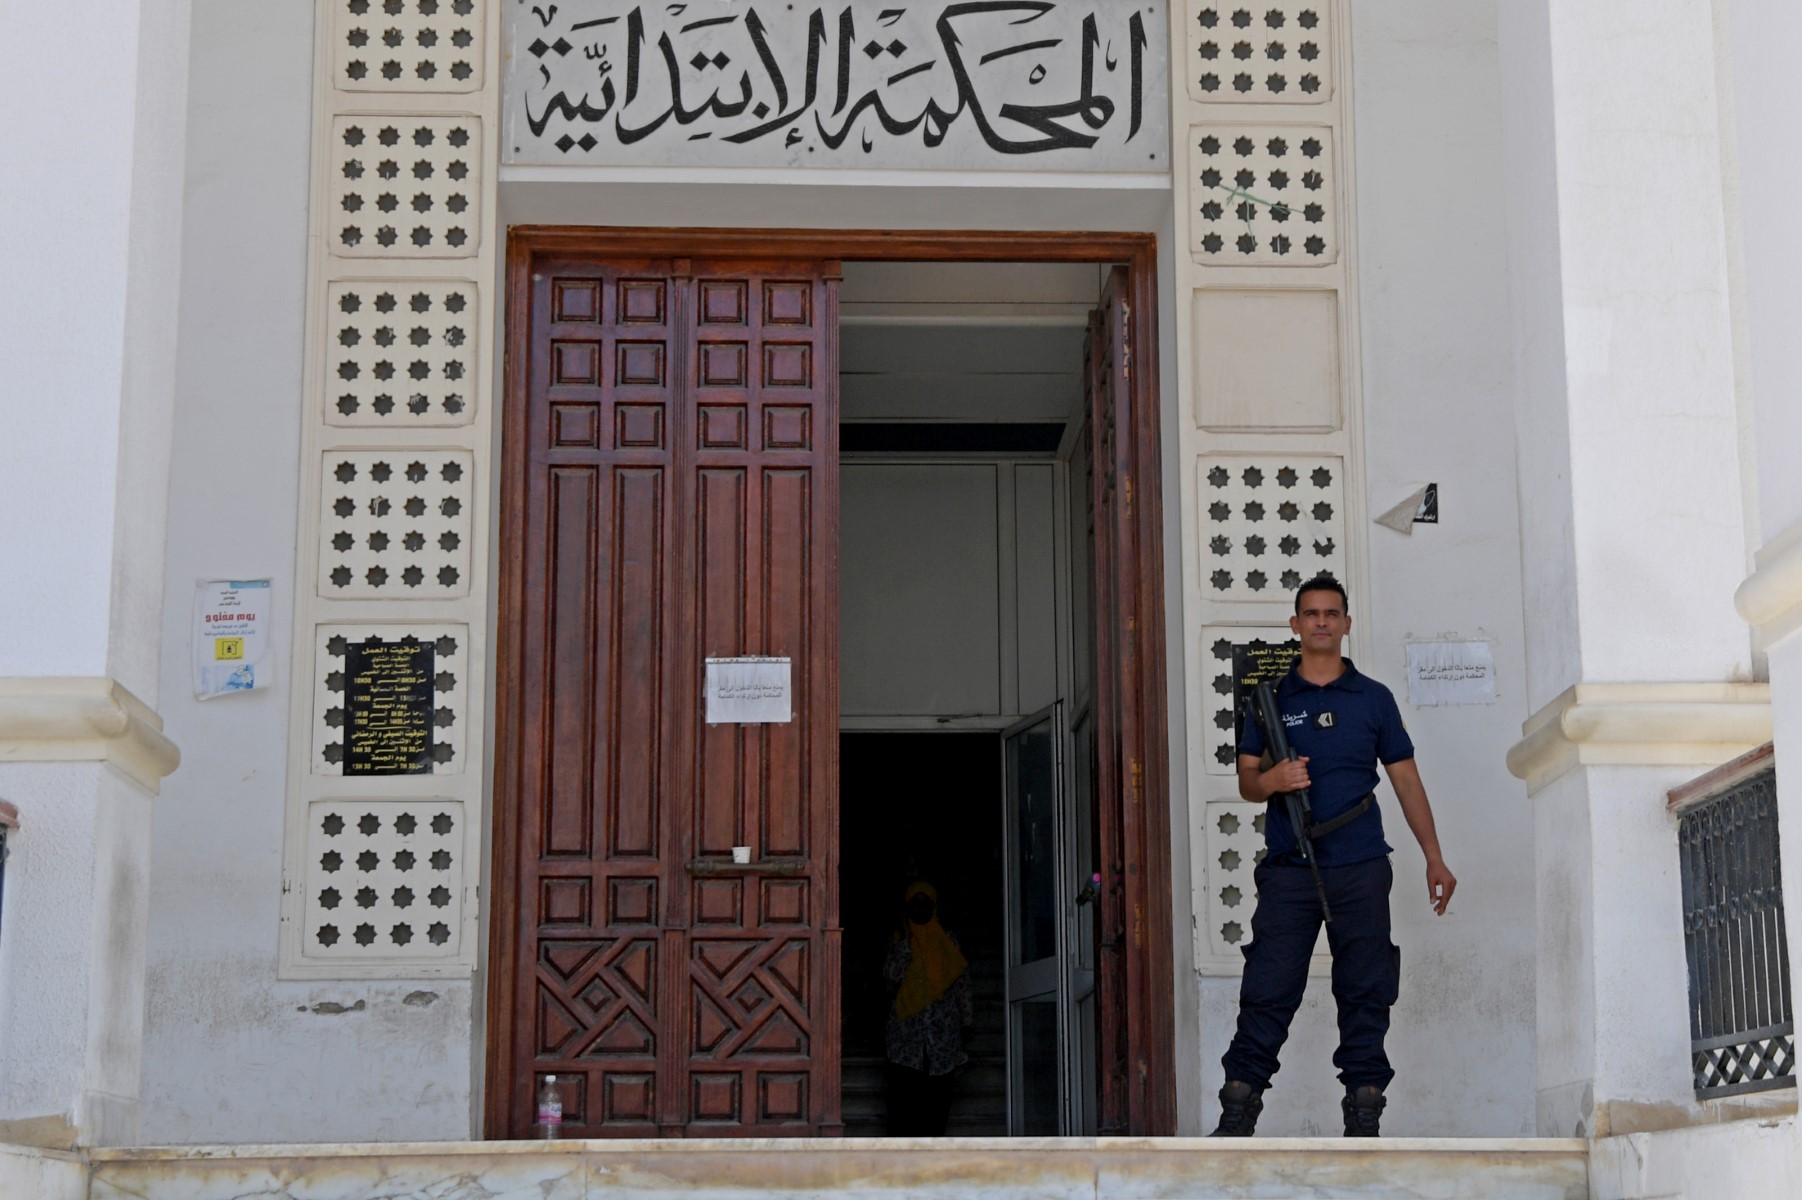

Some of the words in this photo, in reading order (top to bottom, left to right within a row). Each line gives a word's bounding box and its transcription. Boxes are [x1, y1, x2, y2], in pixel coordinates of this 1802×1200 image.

[815, 1, 1148, 154] المحكمة
[361, 647, 388, 655] العمل
[390, 645, 421, 654] توقيت
[1247, 648, 1272, 656] العمل
[1282, 710, 1308, 722] شرطة
[1286, 719, 1304, 727] POLICE
[371, 754, 394, 762] الجمعة
